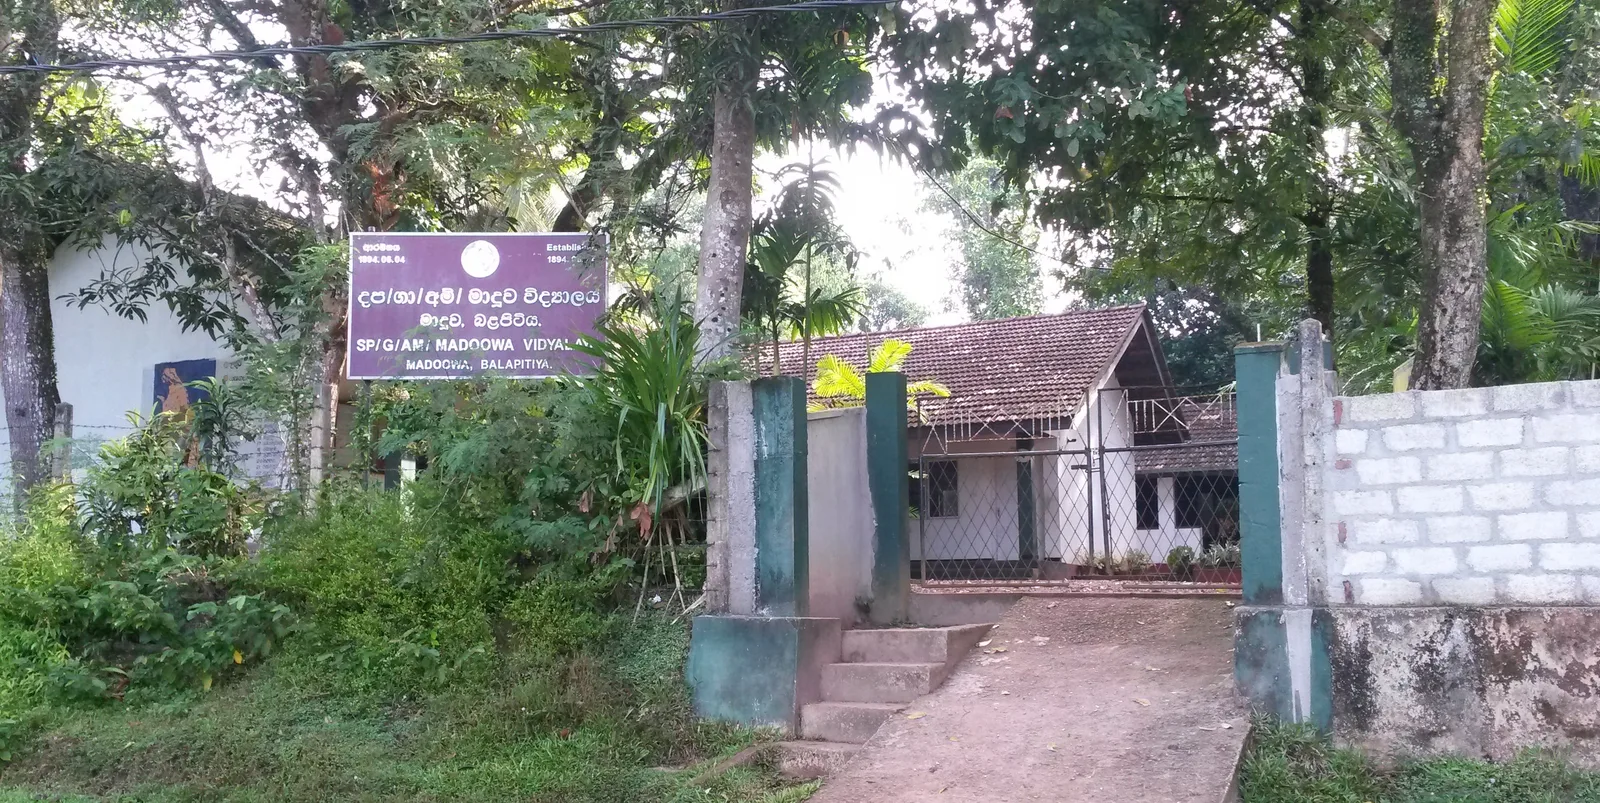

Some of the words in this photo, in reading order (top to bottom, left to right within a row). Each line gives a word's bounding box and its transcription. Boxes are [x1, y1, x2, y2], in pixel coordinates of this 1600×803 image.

[435, 338, 515, 352] MADOOWA
[405, 359, 473, 371] MADOOWA,
[480, 358, 553, 370] BALAPITIYA.
